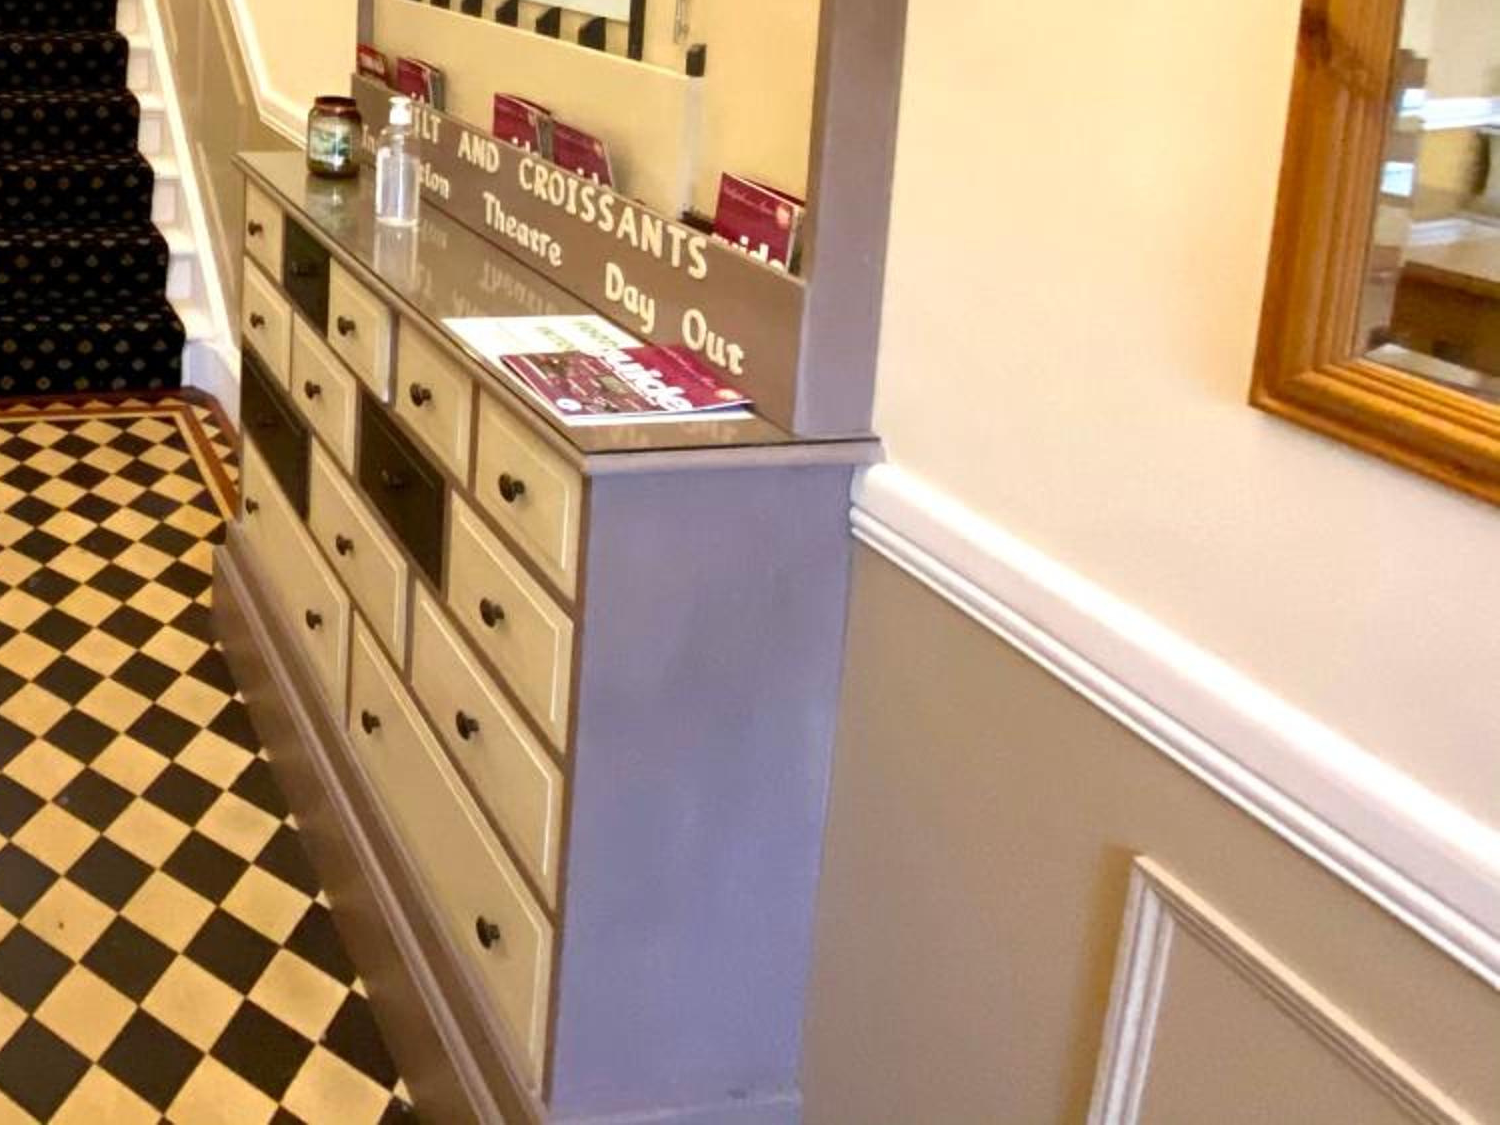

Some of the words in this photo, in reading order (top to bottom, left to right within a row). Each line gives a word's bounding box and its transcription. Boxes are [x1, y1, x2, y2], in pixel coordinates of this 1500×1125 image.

[457, 130, 500, 174] AND
[518, 157, 708, 280] CROISSANTS
[482, 191, 563, 268] Theatre
[604, 262, 656, 334] Day
[681, 308, 745, 374] Out
